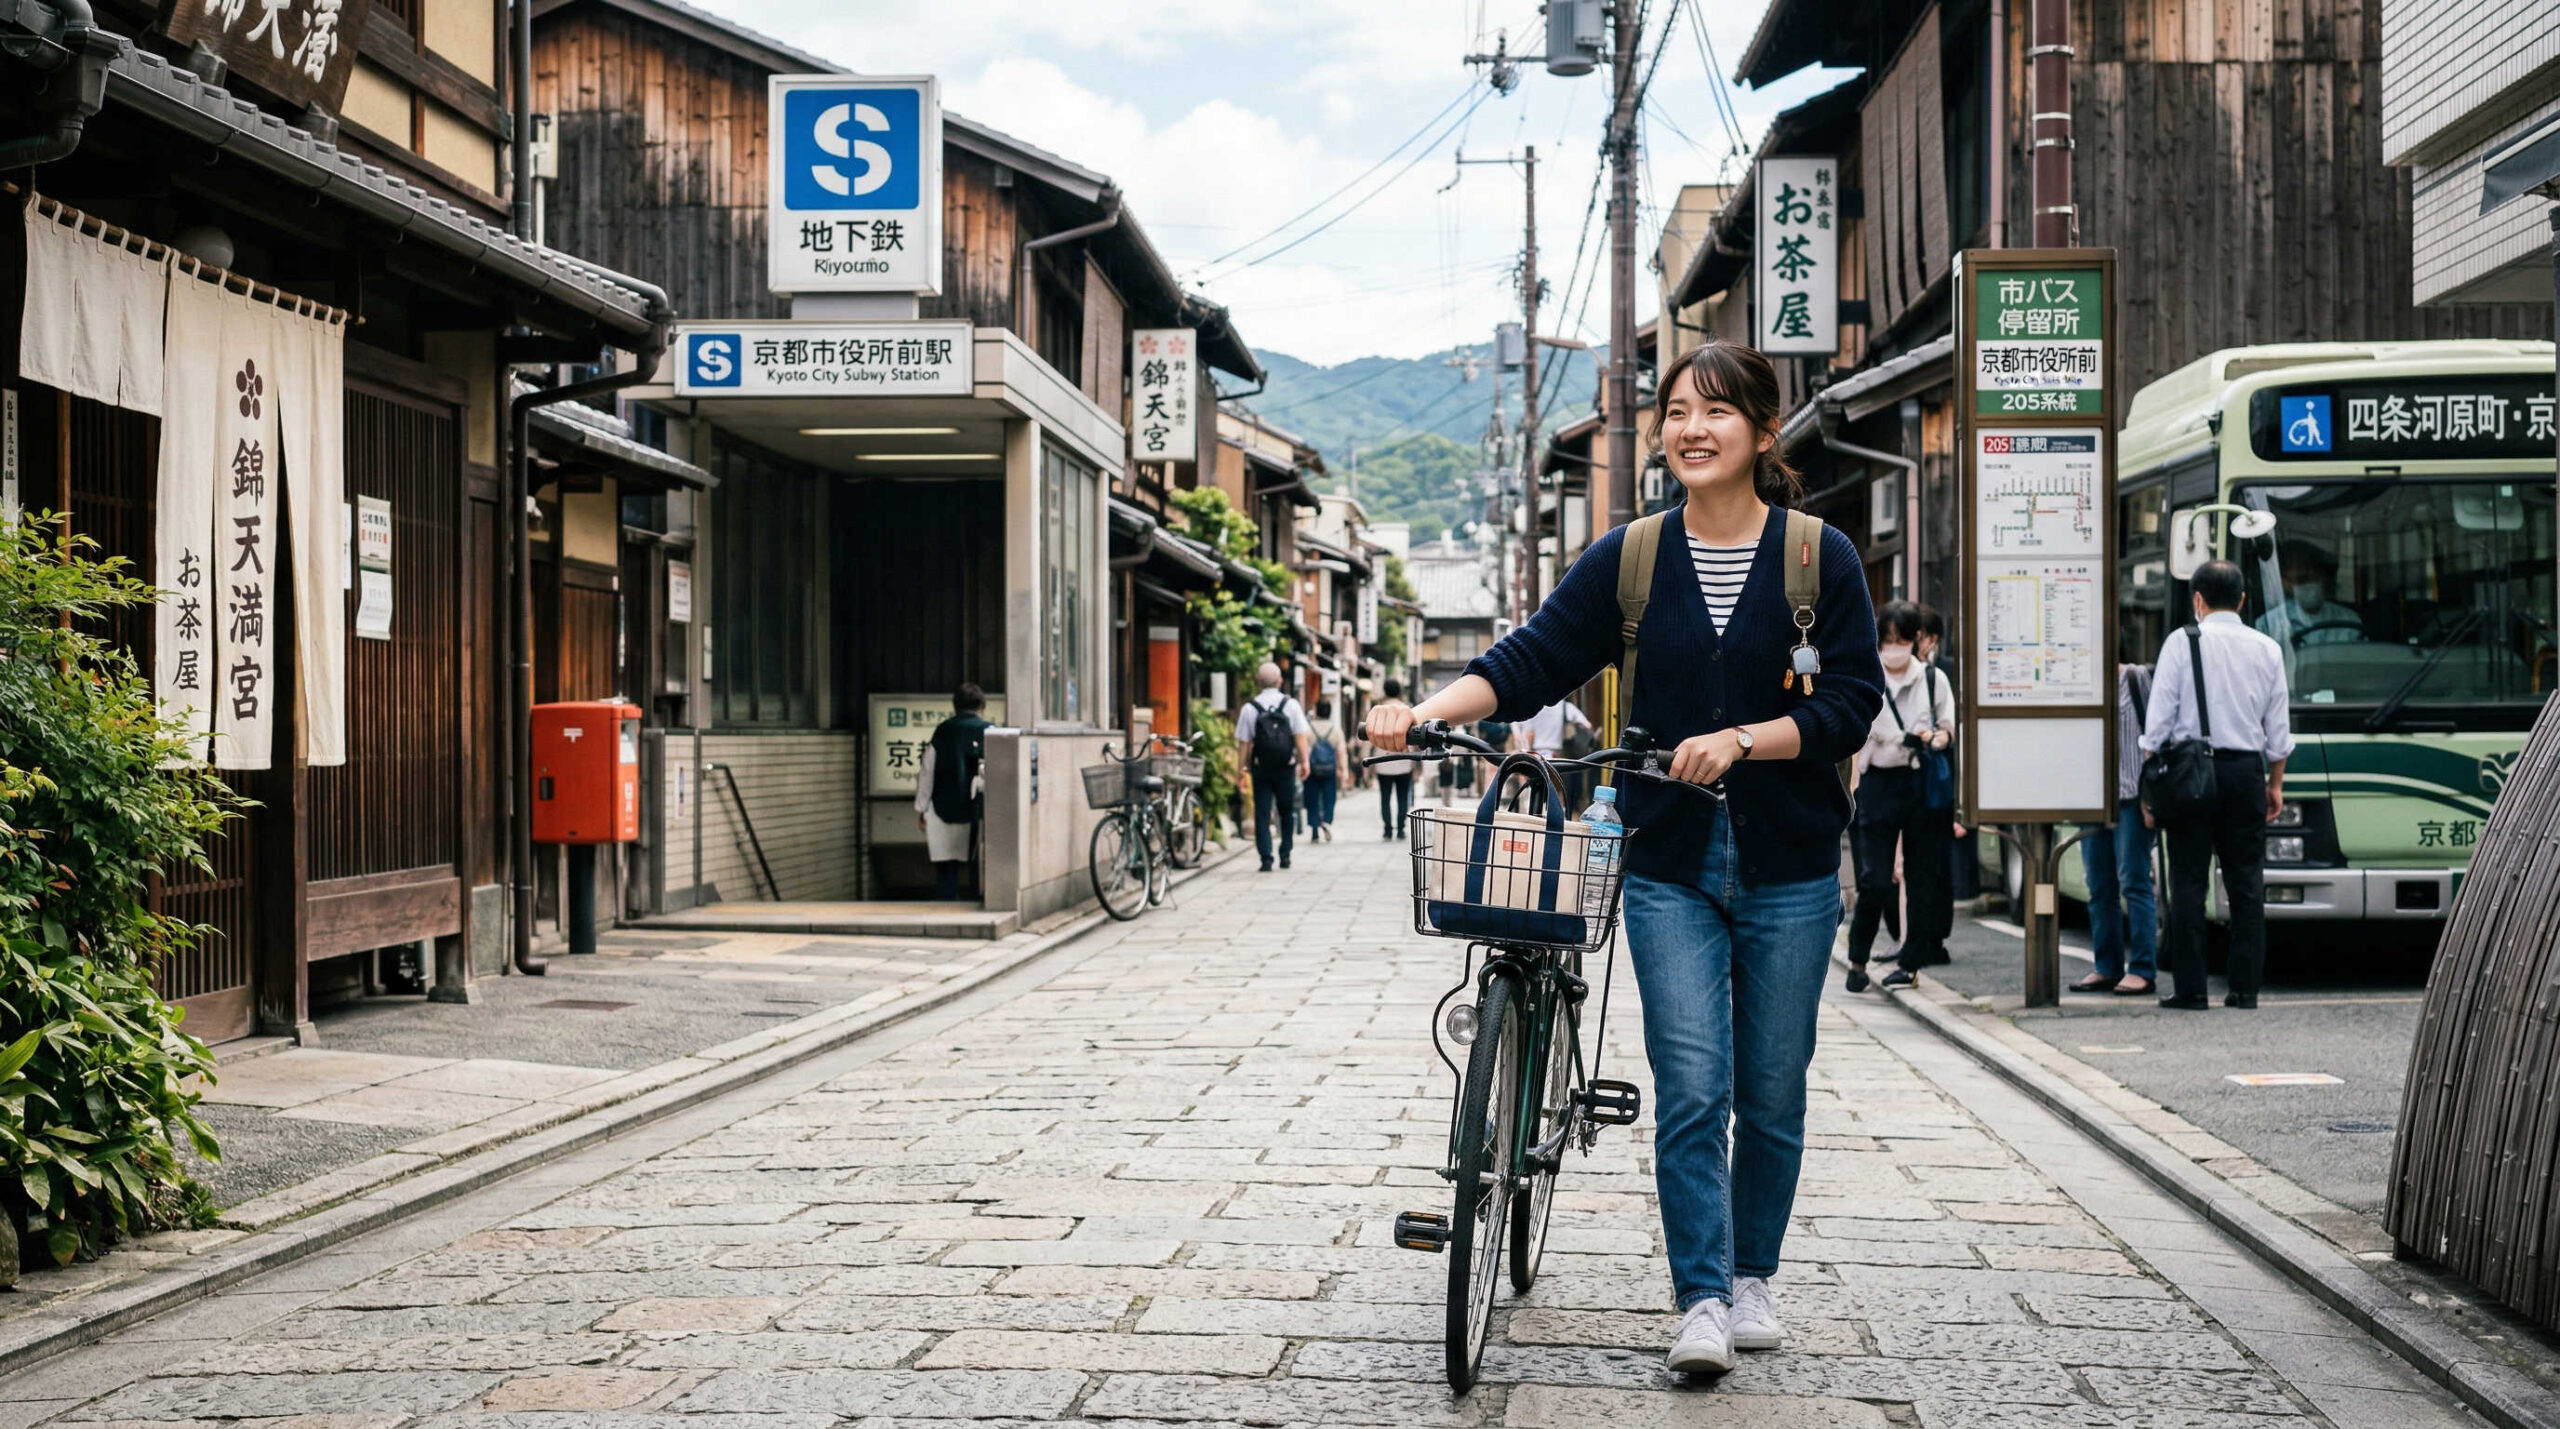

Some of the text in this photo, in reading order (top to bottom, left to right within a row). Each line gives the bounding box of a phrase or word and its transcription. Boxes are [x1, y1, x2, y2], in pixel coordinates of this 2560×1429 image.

[800, 219, 904, 253] 地下鉄
[1772, 182, 1818, 339] お茶屋
[1998, 278, 2079, 305] 市バス
[1998, 308, 2080, 336] 停留所
[753, 339, 953, 366] 京都市役所前駅
[1981, 347, 2097, 373] 京都市役所前
[767, 368, 808, 384] Kyoto
[812, 368, 840, 384] City
[892, 367, 940, 381] Station
[1140, 358, 1170, 452] 錦天宮
[2002, 392, 2078, 412] 205系統
[1986, 437, 2009, 453] 205
[229, 437, 265, 721] 錦天満宮
[173, 547, 202, 691] お茶屋
[2417, 820, 2487, 848] 京都
